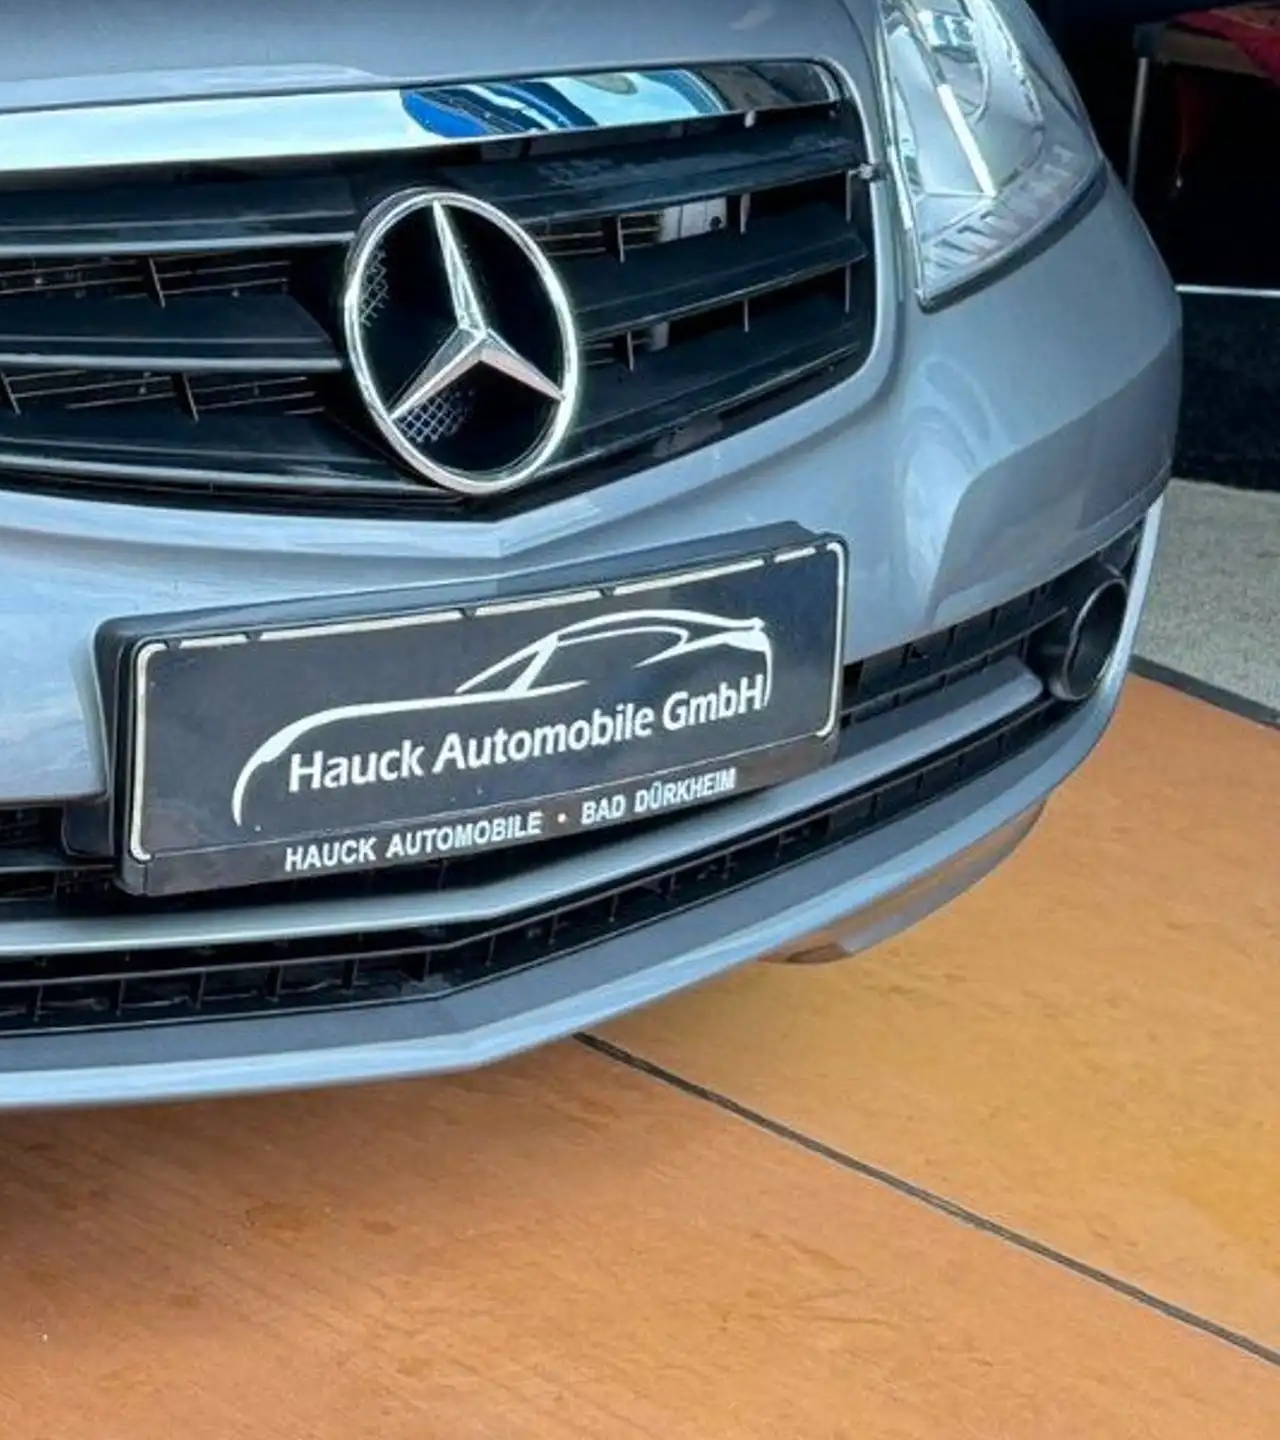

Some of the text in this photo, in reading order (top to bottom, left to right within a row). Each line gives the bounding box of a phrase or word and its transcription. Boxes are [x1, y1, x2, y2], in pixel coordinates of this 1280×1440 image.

[288, 673, 765, 793] Hauck Automobile GmbH
[284, 767, 737, 872] HAUCK AUTOMOBILE BAD DÜRKHEIM
